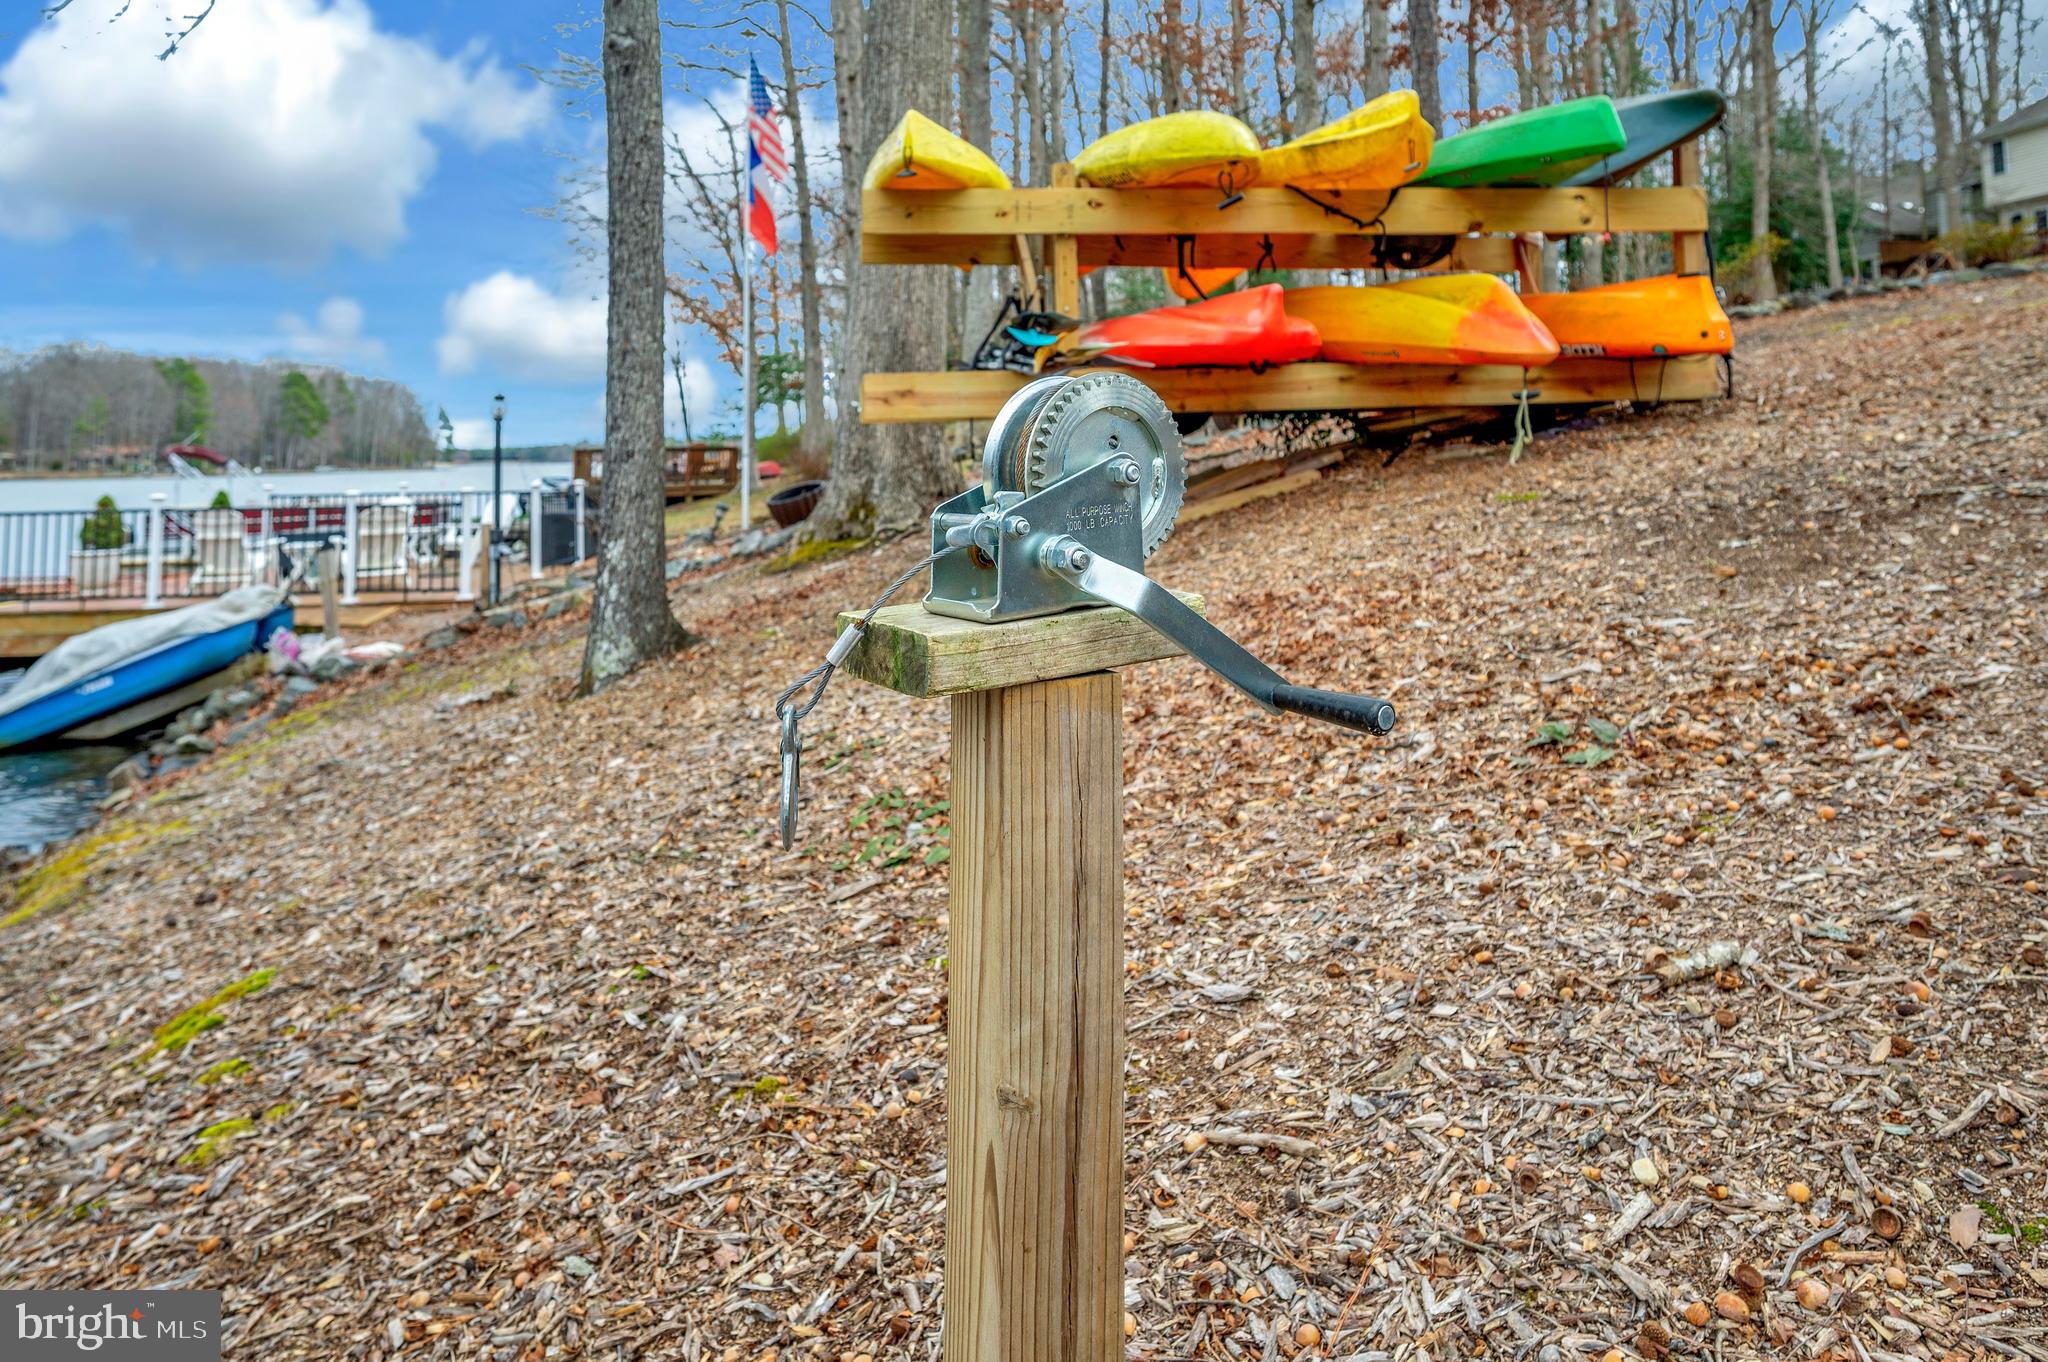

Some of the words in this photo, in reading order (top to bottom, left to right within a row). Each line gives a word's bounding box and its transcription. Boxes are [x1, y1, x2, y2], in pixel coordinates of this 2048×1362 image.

[1065, 507, 1079, 519] ALL
[1081, 504, 1111, 518] PURPOSE
[1113, 502, 1133, 513] WINCH
[1066, 520, 1082, 531] 1000
[1086, 518, 1095, 529] LB
[1100, 513, 1134, 528] CAPACITY
